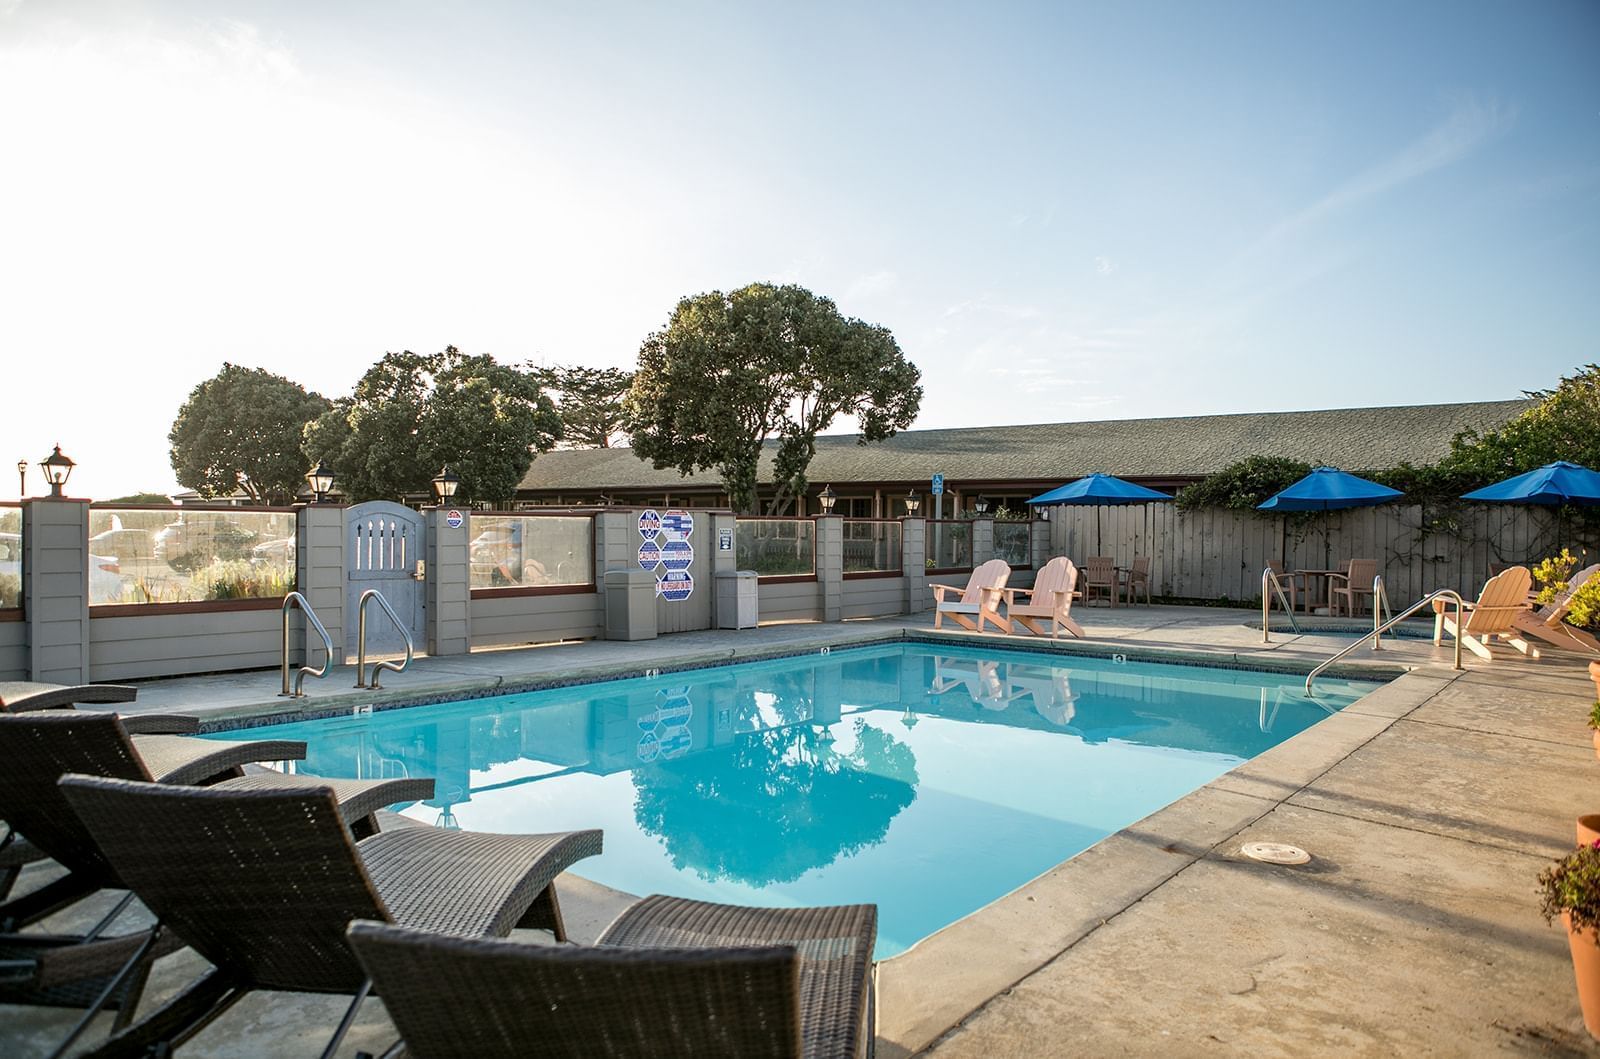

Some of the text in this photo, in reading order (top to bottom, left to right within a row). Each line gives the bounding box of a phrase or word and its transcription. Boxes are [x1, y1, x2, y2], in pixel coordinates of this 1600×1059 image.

[645, 512, 655, 520] NO
[640, 520, 660, 528] DIVING
[639, 552, 660, 560] CAUTION
